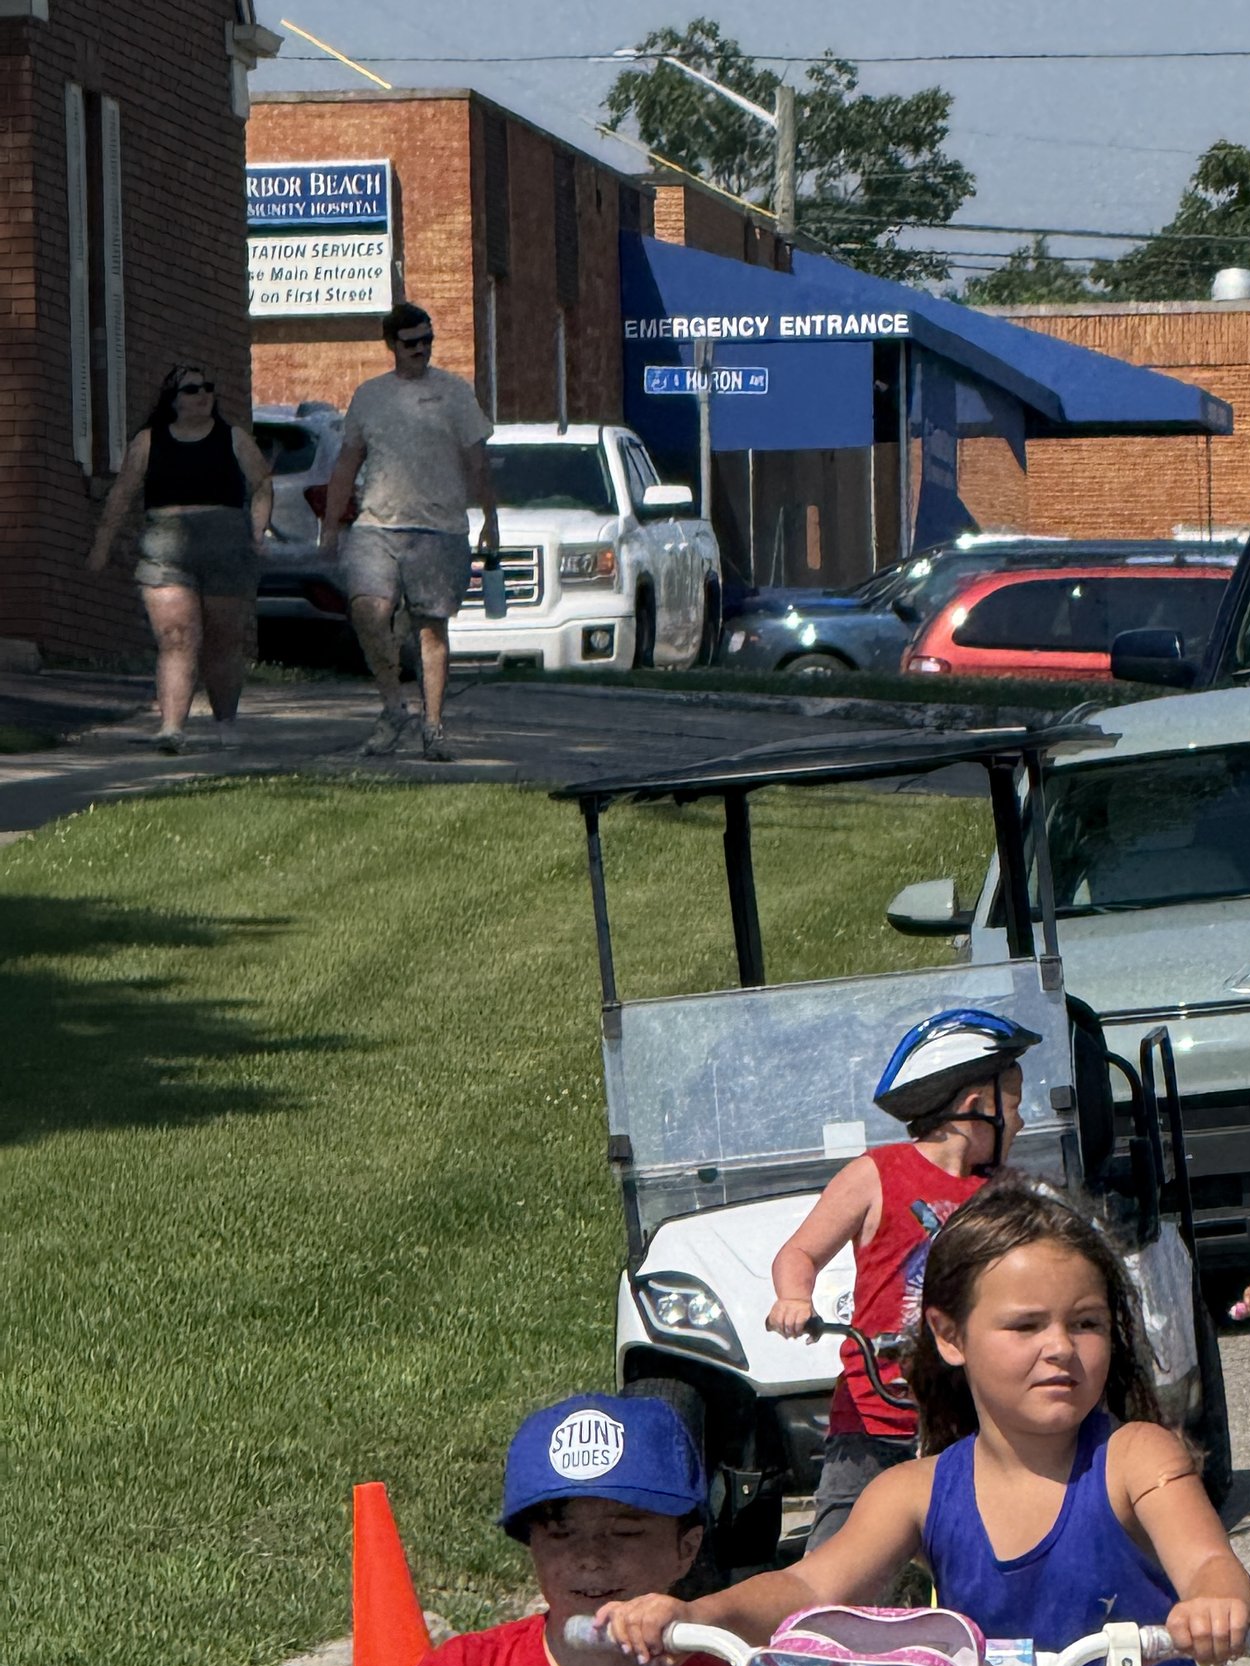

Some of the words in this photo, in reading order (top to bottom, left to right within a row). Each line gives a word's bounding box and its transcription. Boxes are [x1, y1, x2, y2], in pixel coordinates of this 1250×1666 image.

[310, 172, 381, 197] BEACH
[311, 200, 379, 217] HOSPITAL
[312, 242, 384, 258] SERVICES
[270, 266, 309, 281] Main
[314, 266, 383, 281] Entrance
[260, 292, 280, 303] on
[286, 288, 320, 304] First
[325, 286, 373, 302] Street
[624, 315, 769, 339] EMERGENCY
[779, 313, 910, 336] ENTRANCE
[552, 1419, 622, 1454] STUNT
[562, 1448, 610, 1470] DUDES
